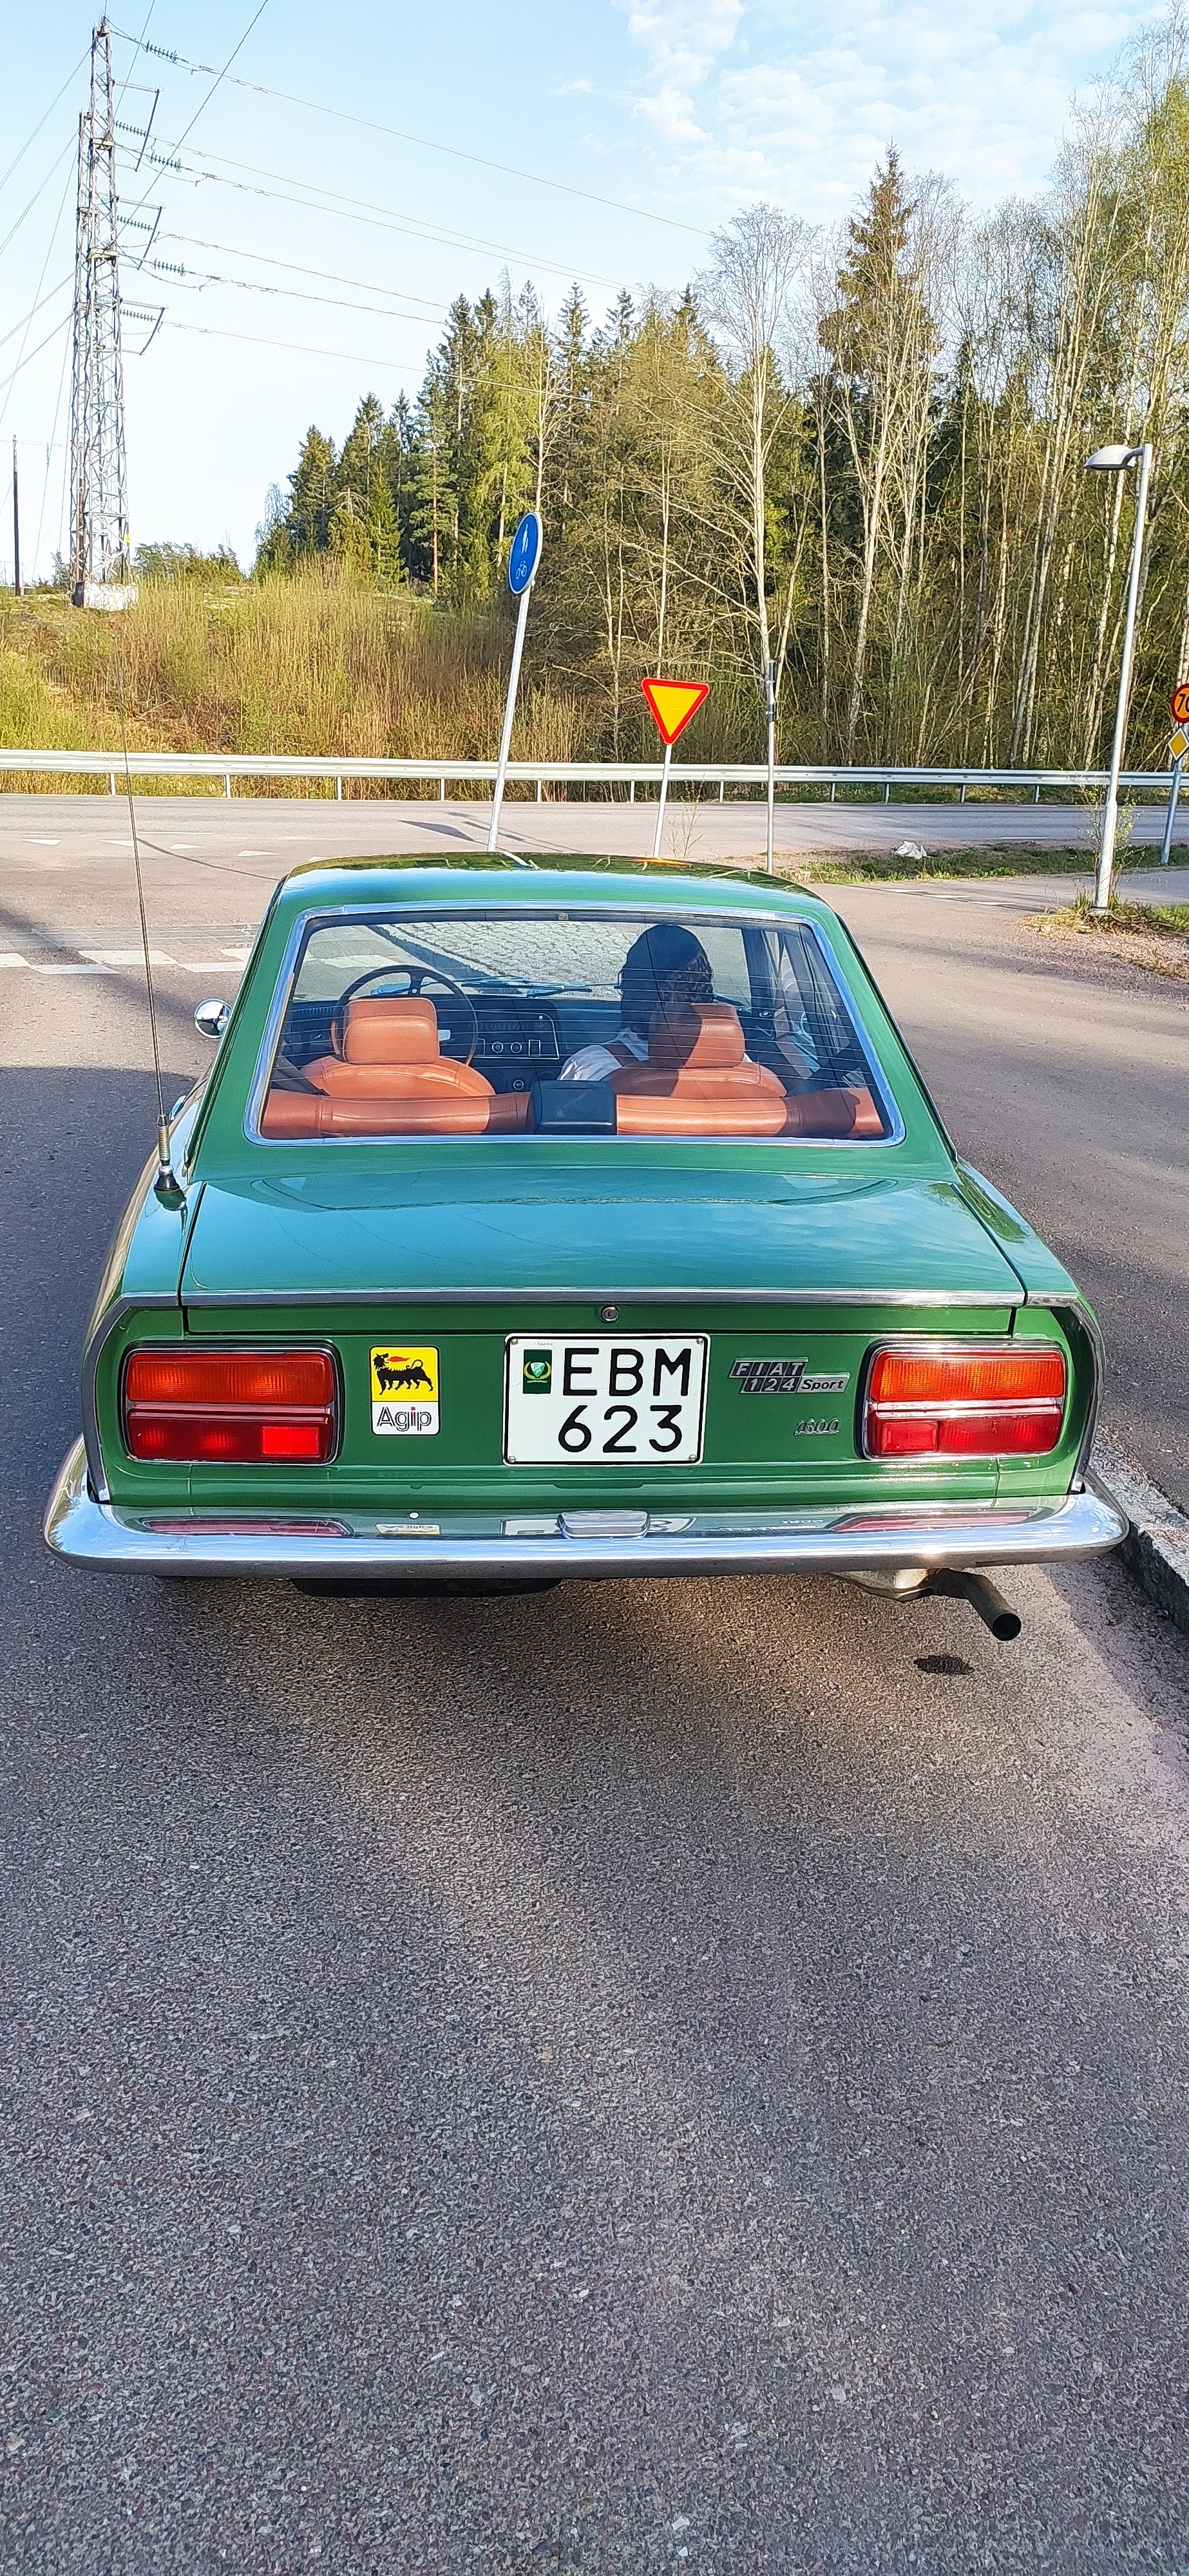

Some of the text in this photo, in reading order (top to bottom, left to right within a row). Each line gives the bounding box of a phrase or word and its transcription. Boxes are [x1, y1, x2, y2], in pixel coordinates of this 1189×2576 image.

[563, 1348, 692, 1396] EBM
[736, 1362, 803, 1376] FIAT
[750, 1378, 844, 1392] 124 Sport
[377, 1406, 432, 1432] Agip
[558, 1405, 682, 1453] 623
